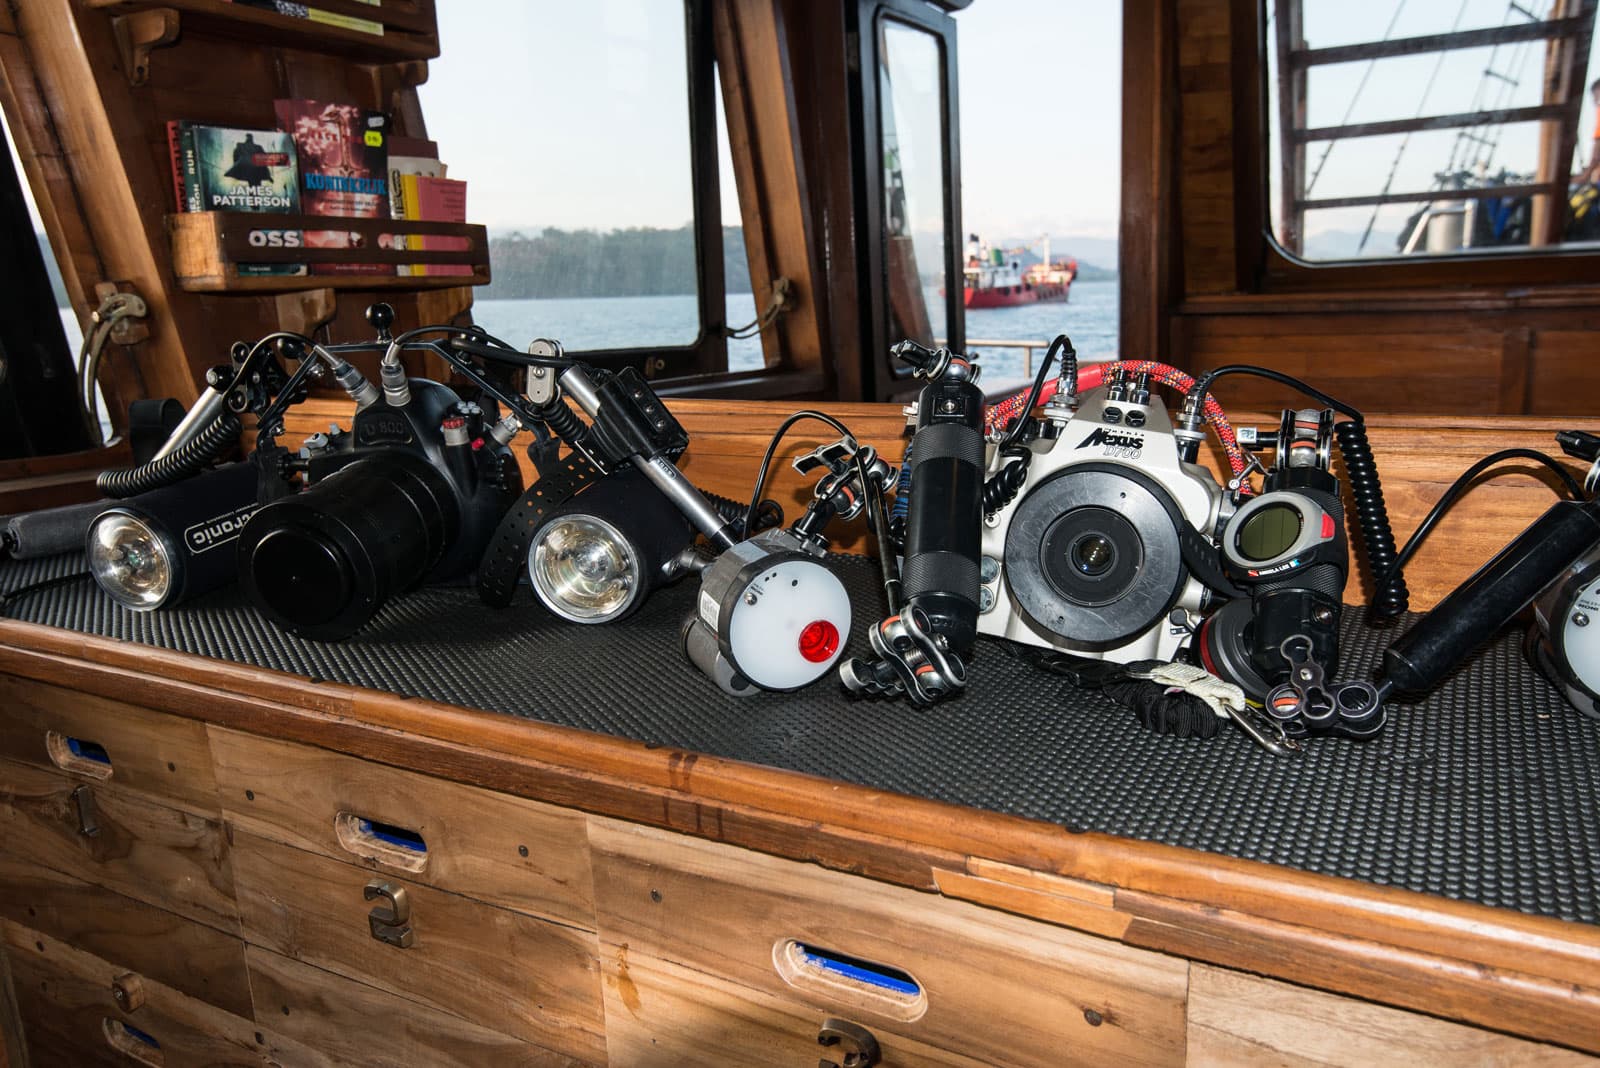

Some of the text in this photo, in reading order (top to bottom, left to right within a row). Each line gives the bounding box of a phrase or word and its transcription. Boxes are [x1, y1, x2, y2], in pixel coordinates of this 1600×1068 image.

[186, 150, 196, 175] RUN
[229, 186, 273, 196] JAMES
[212, 195, 291, 208] PATTERSON
[248, 230, 300, 248] OSS
[1103, 445, 1143, 460] D700
